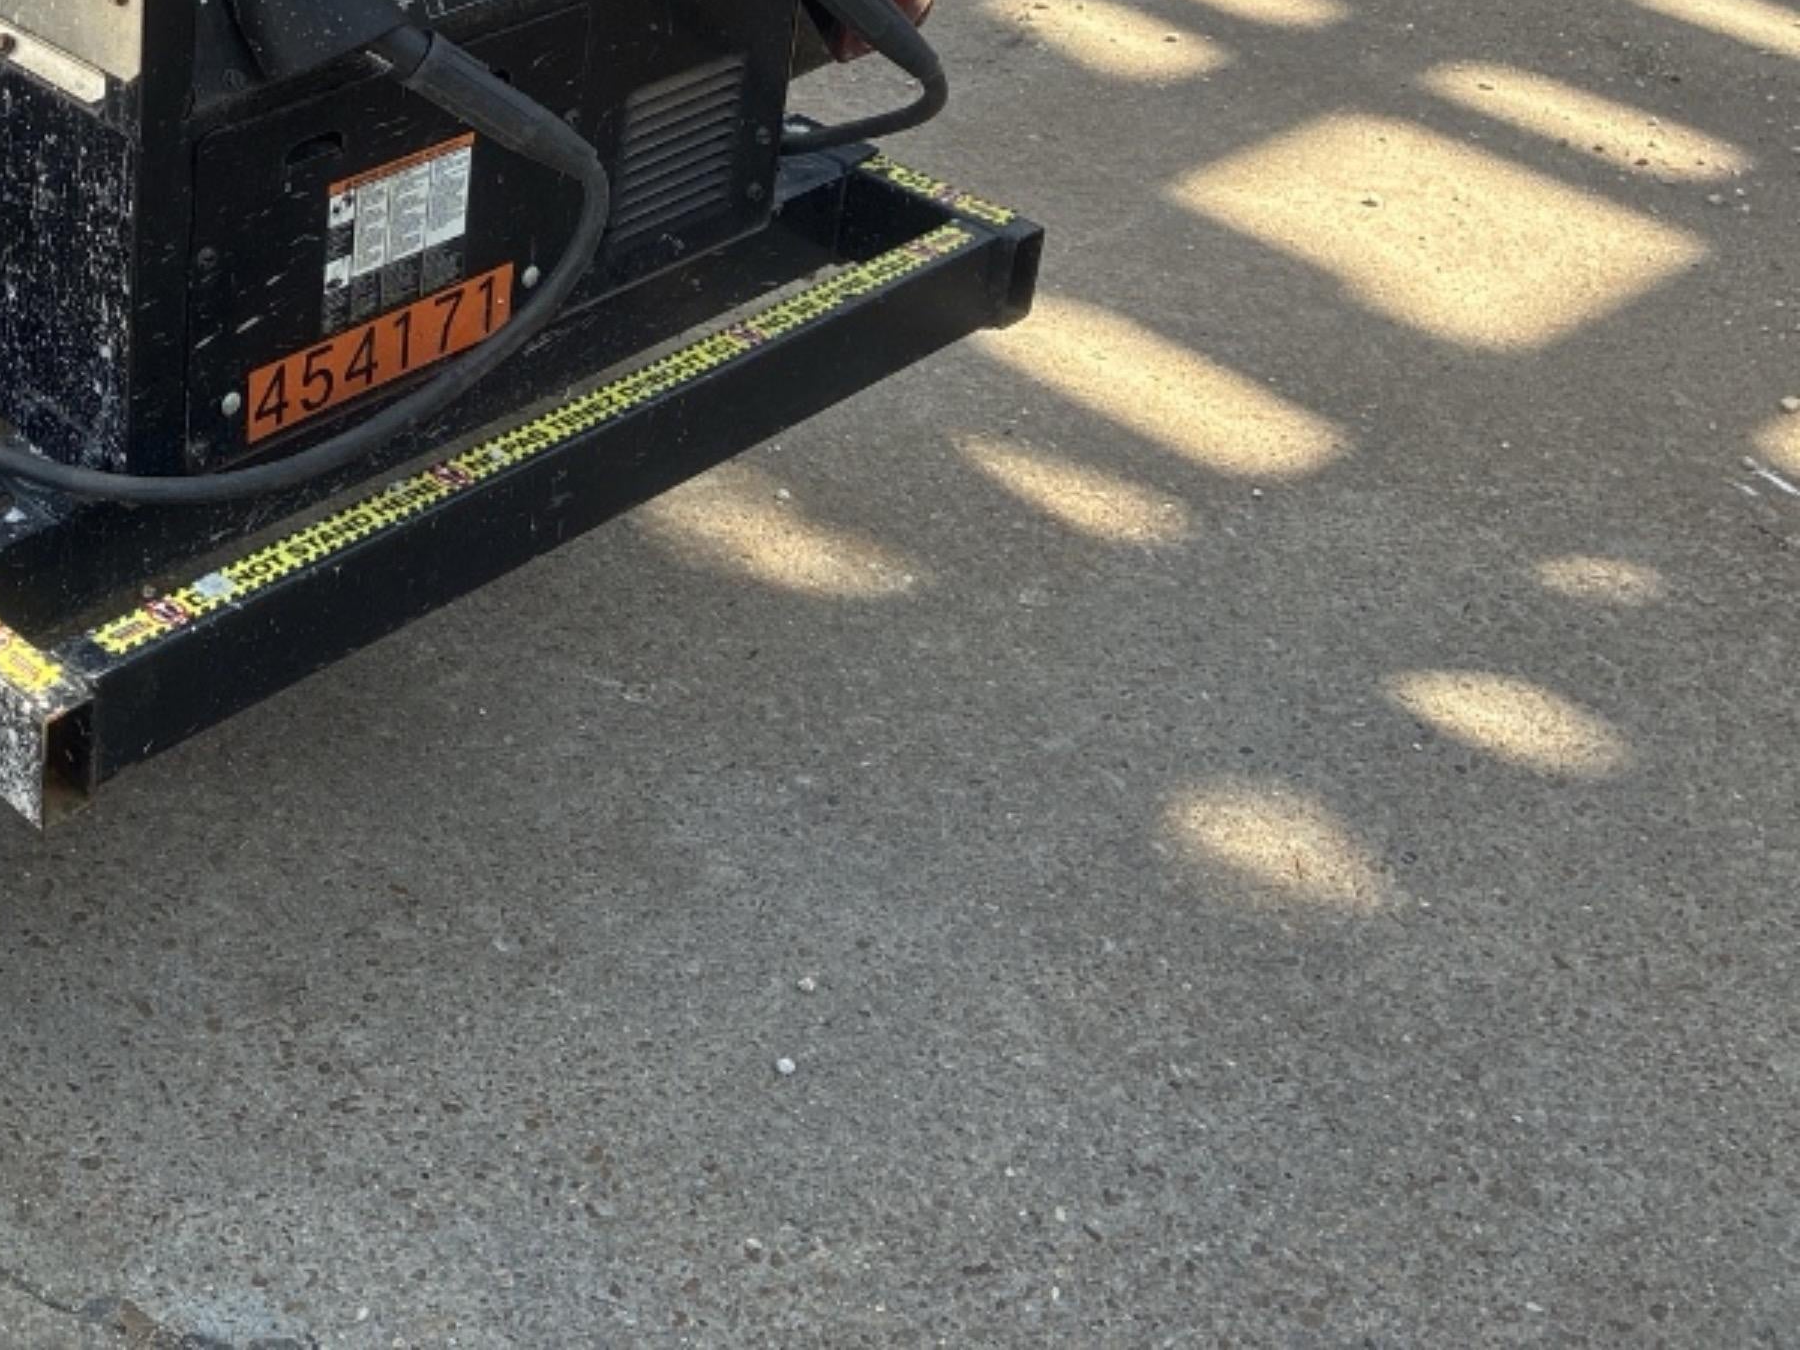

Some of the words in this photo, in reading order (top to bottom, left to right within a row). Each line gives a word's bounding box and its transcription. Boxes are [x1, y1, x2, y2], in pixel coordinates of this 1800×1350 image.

[253, 274, 496, 426] 454171
[231, 553, 283, 588] NOT
[287, 507, 373, 563] STAND
